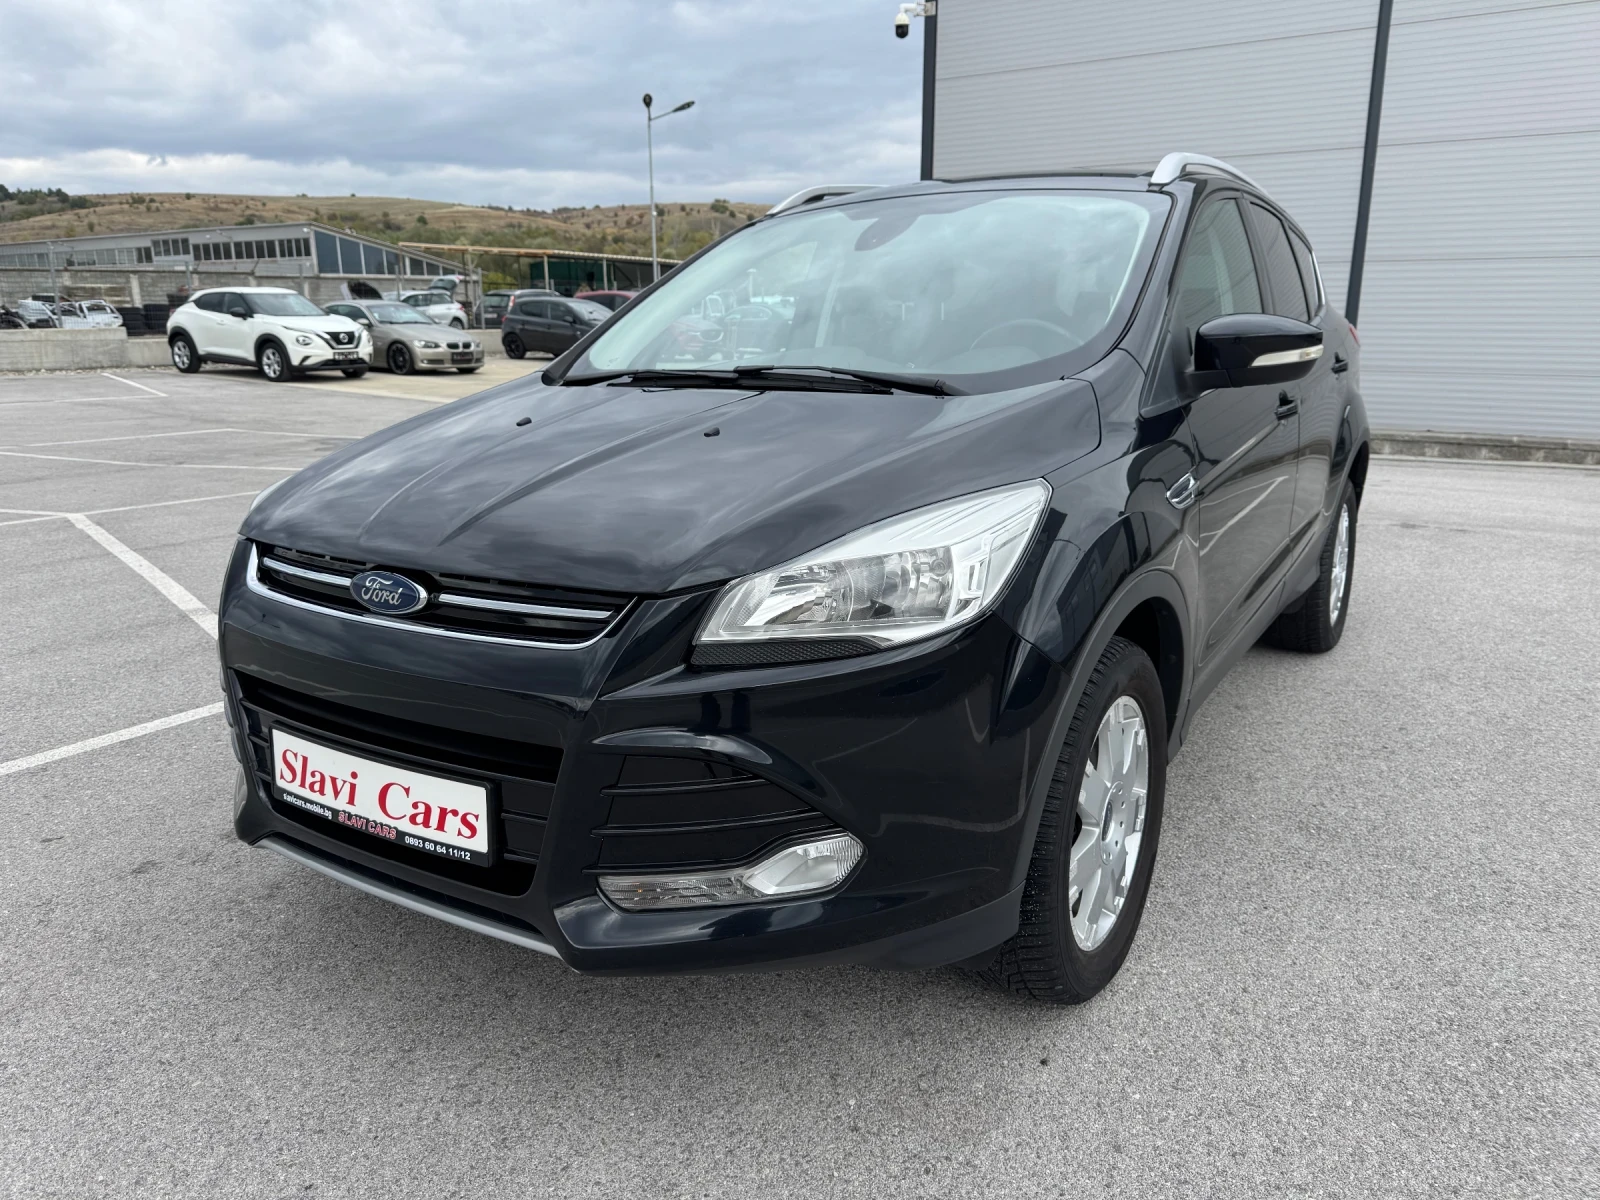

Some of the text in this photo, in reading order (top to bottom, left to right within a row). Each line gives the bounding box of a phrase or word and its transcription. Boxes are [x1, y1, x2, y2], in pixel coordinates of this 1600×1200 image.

[361, 576, 403, 605] Ford
[279, 748, 480, 840] Slavi Cars
[282, 792, 333, 820] slavicars.mobile.bg
[338, 811, 397, 840] SLAVI CARS
[404, 835, 471, 861] 0893 60 64 11/12
